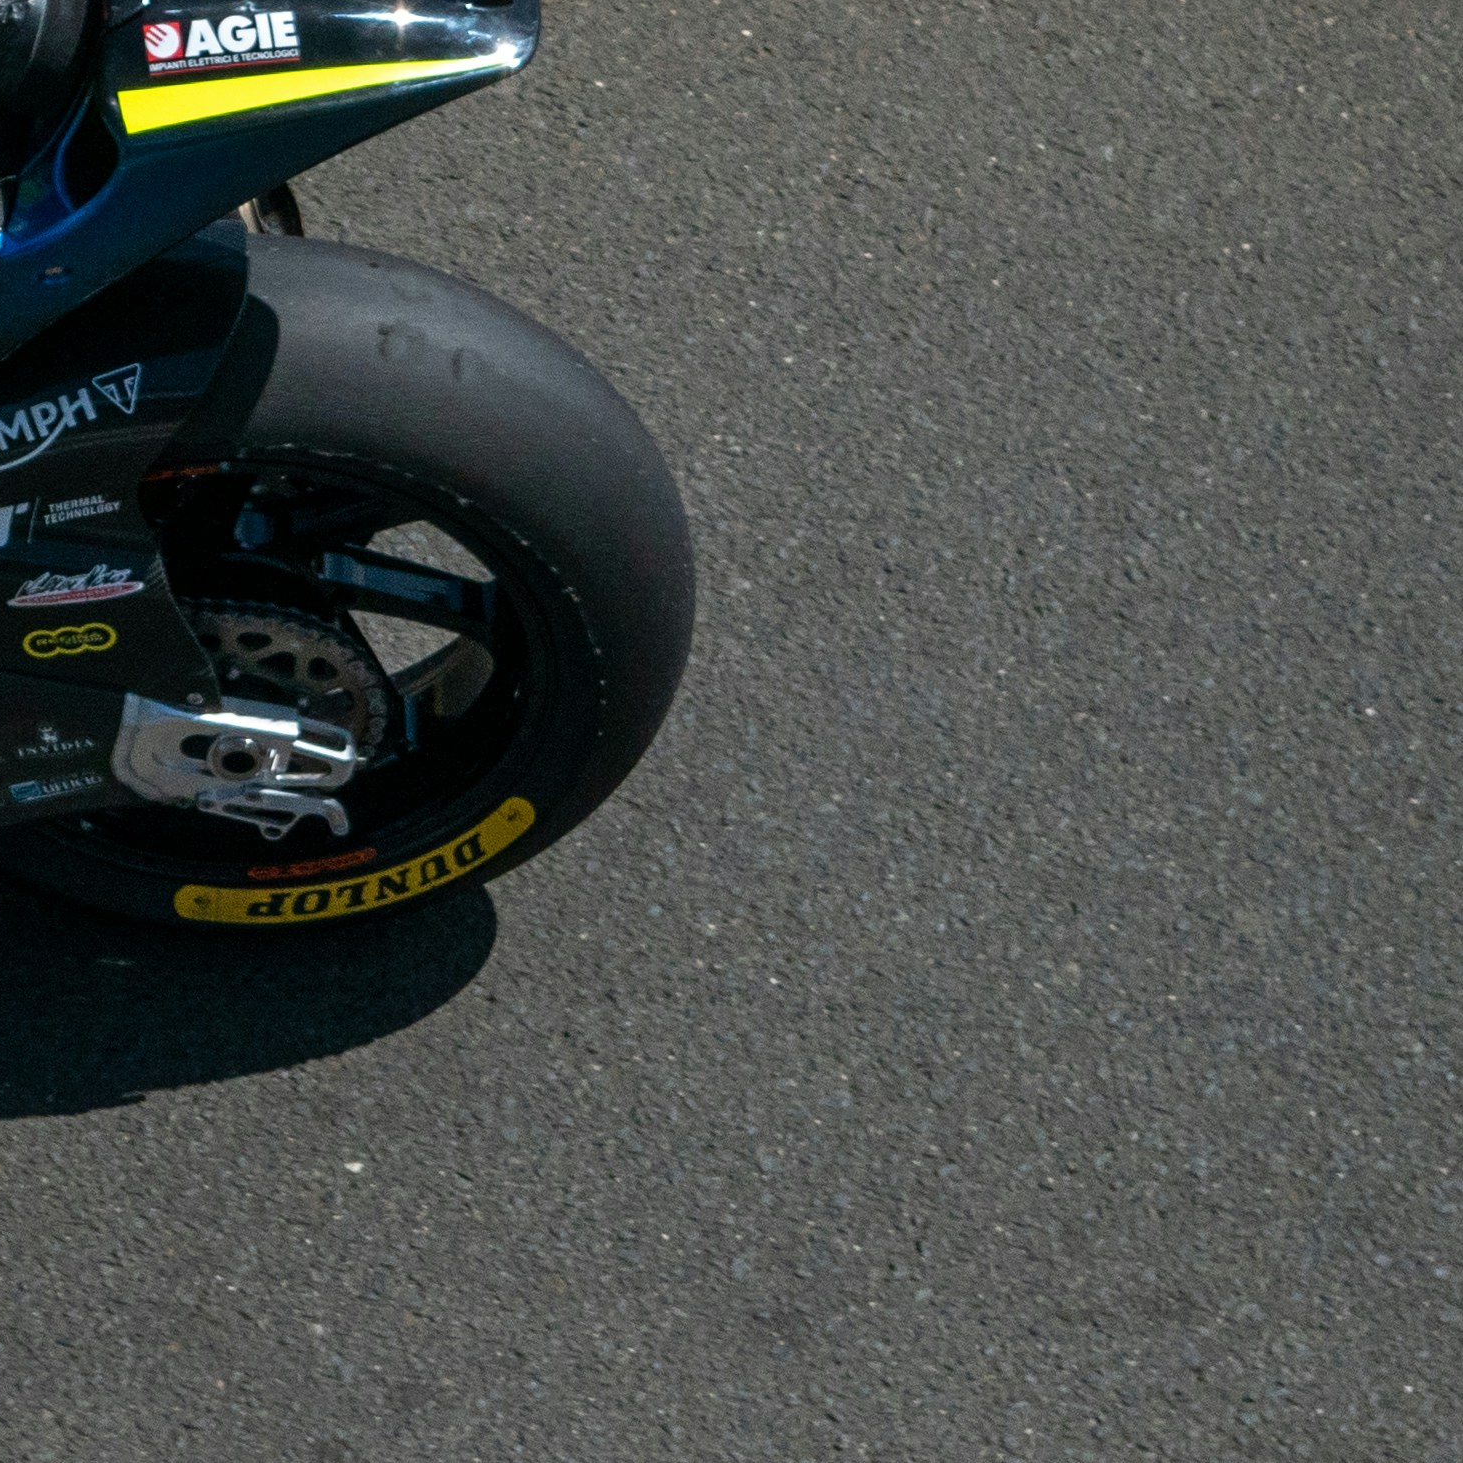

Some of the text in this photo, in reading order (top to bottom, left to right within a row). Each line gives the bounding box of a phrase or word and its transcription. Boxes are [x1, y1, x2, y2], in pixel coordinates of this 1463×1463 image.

[185, 11, 299, 57] AGIE
[149, 47, 299, 72] IMPIANTI ELETTRICI E TECNOLOGICI
[43, 500, 121, 526] TECHNOLOGY
[47, 494, 106, 513] THERMAL
[246, 833, 487, 918] DUNLOP
